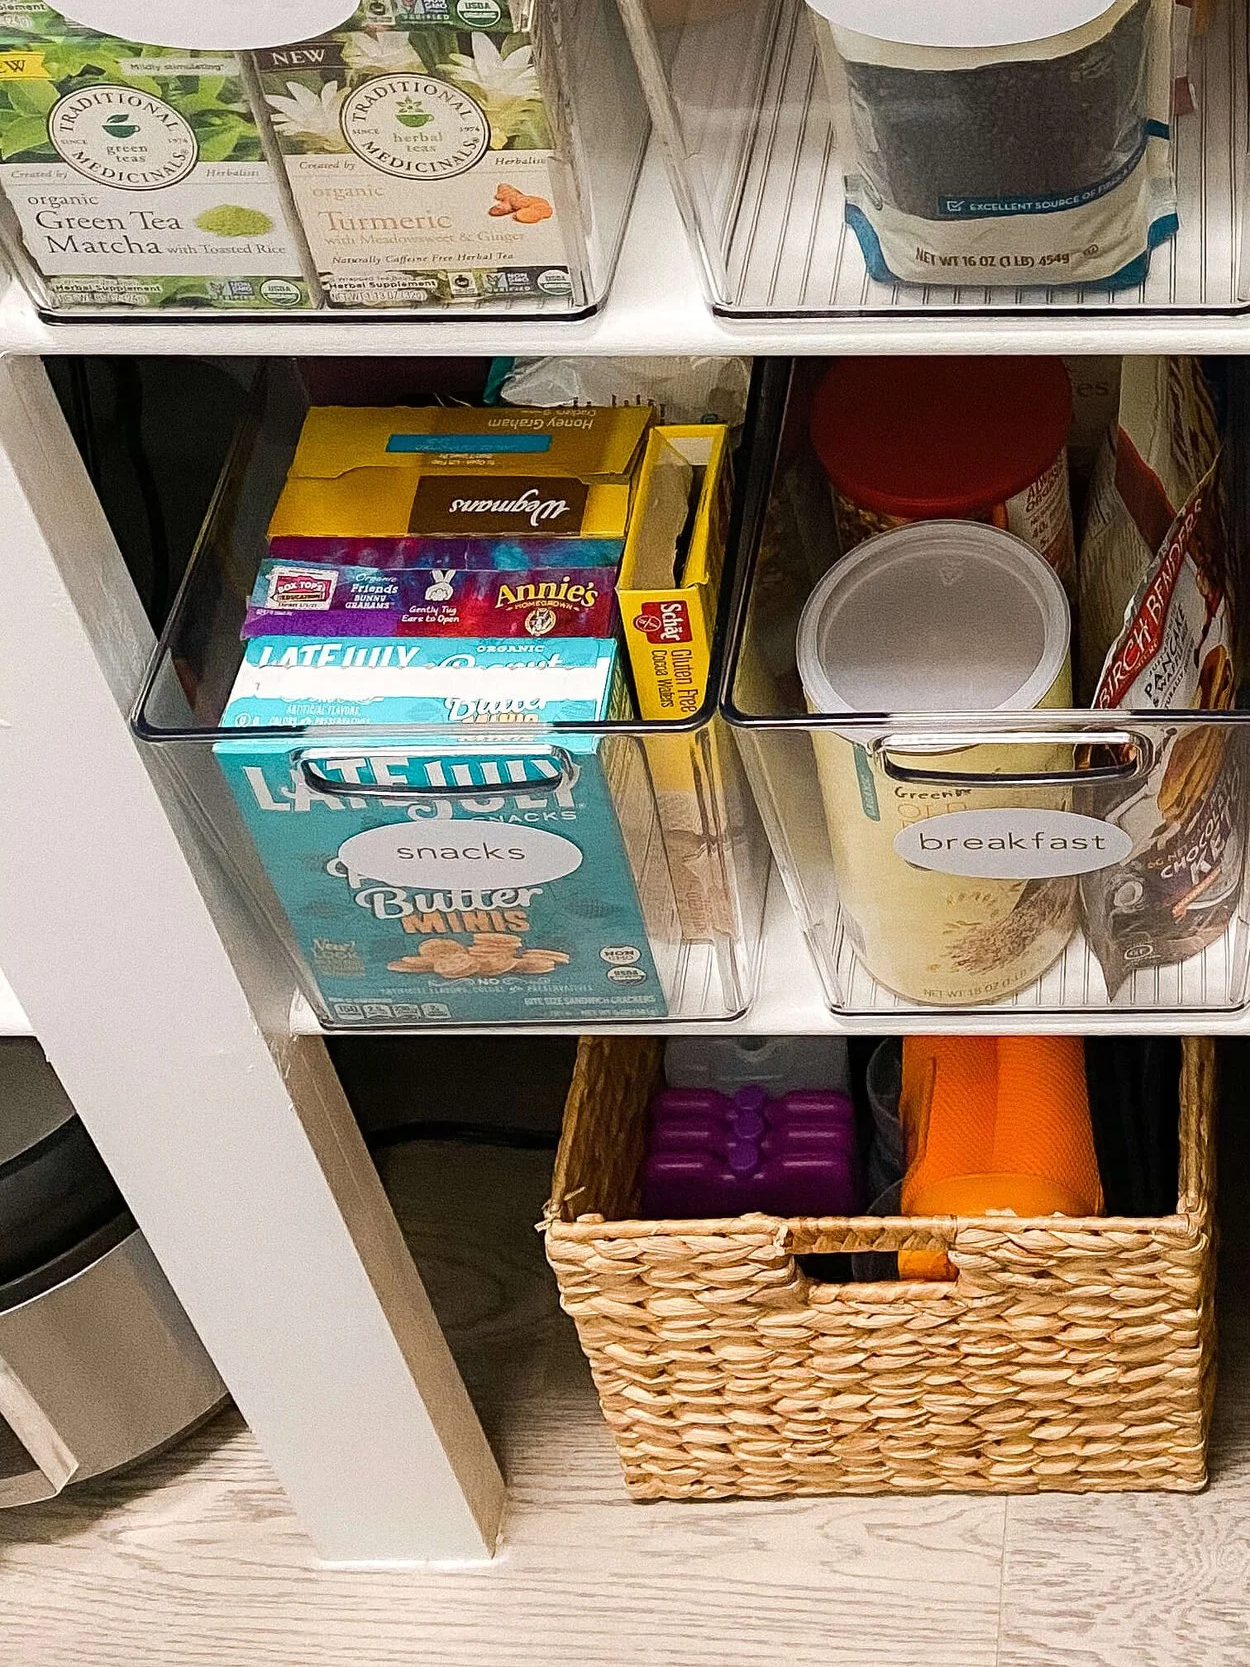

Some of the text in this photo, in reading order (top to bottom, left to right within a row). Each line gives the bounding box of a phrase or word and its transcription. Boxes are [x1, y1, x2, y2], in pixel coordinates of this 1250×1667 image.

[271, 48, 326, 67] NEW
[59, 91, 182, 134] TRADITIONAL
[352, 81, 474, 124] TRADITIONAL
[71, 148, 187, 184] MEDICINALS
[361, 137, 480, 174] MEDICINALS
[27, 193, 100, 209] organic
[35, 210, 184, 231] Green Tea
[318, 210, 454, 232] Turmeric
[47, 234, 286, 255] Matcha with Toasted Rice
[487, 416, 595, 430] Honey Graham
[449, 490, 570, 526] Wegmans
[350, 582, 399, 595] Friends
[494, 575, 600, 609] Annie's
[401, 613, 460, 625] Ears to Open
[408, 605, 458, 617] Gently Tug
[657, 602, 683, 643] Schär
[671, 648, 699, 713] Gluten Free
[396, 842, 527, 862] snacks
[918, 831, 1107, 851] breakfast
[354, 887, 544, 920] Butter
[400, 910, 531, 935] MINIS
